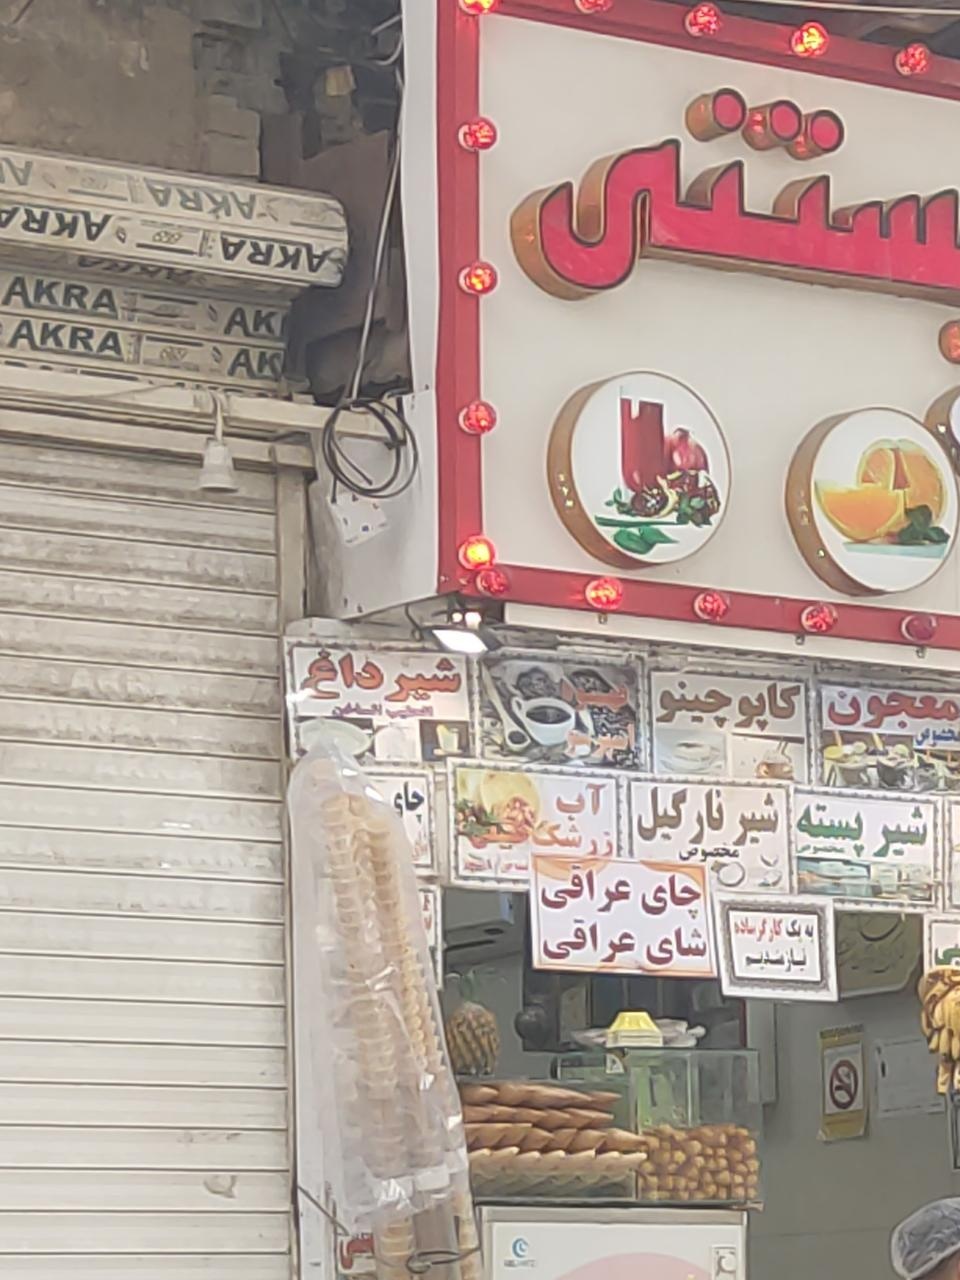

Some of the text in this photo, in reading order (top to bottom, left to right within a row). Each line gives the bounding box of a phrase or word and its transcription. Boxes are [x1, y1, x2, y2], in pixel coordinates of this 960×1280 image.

[143, 177, 261, 221] AKRA
[219, 231, 335, 274] AKRA
[3, 275, 119, 320] AKRA
[8, 319, 124, 356] AKRA
[224, 306, 286, 338] AK
[227, 348, 286, 380] AK
[302, 650, 461, 702] شیر داغ
[828, 690, 960, 729] معجون
[556, 783, 607, 821] آب
[732, 792, 779, 846] شیر
[531, 821, 613, 858] زرشک
[797, 803, 927, 857] شیر پسته
[541, 865, 701, 920] چای عراقی
[542, 918, 707, 966] شای عراقی
